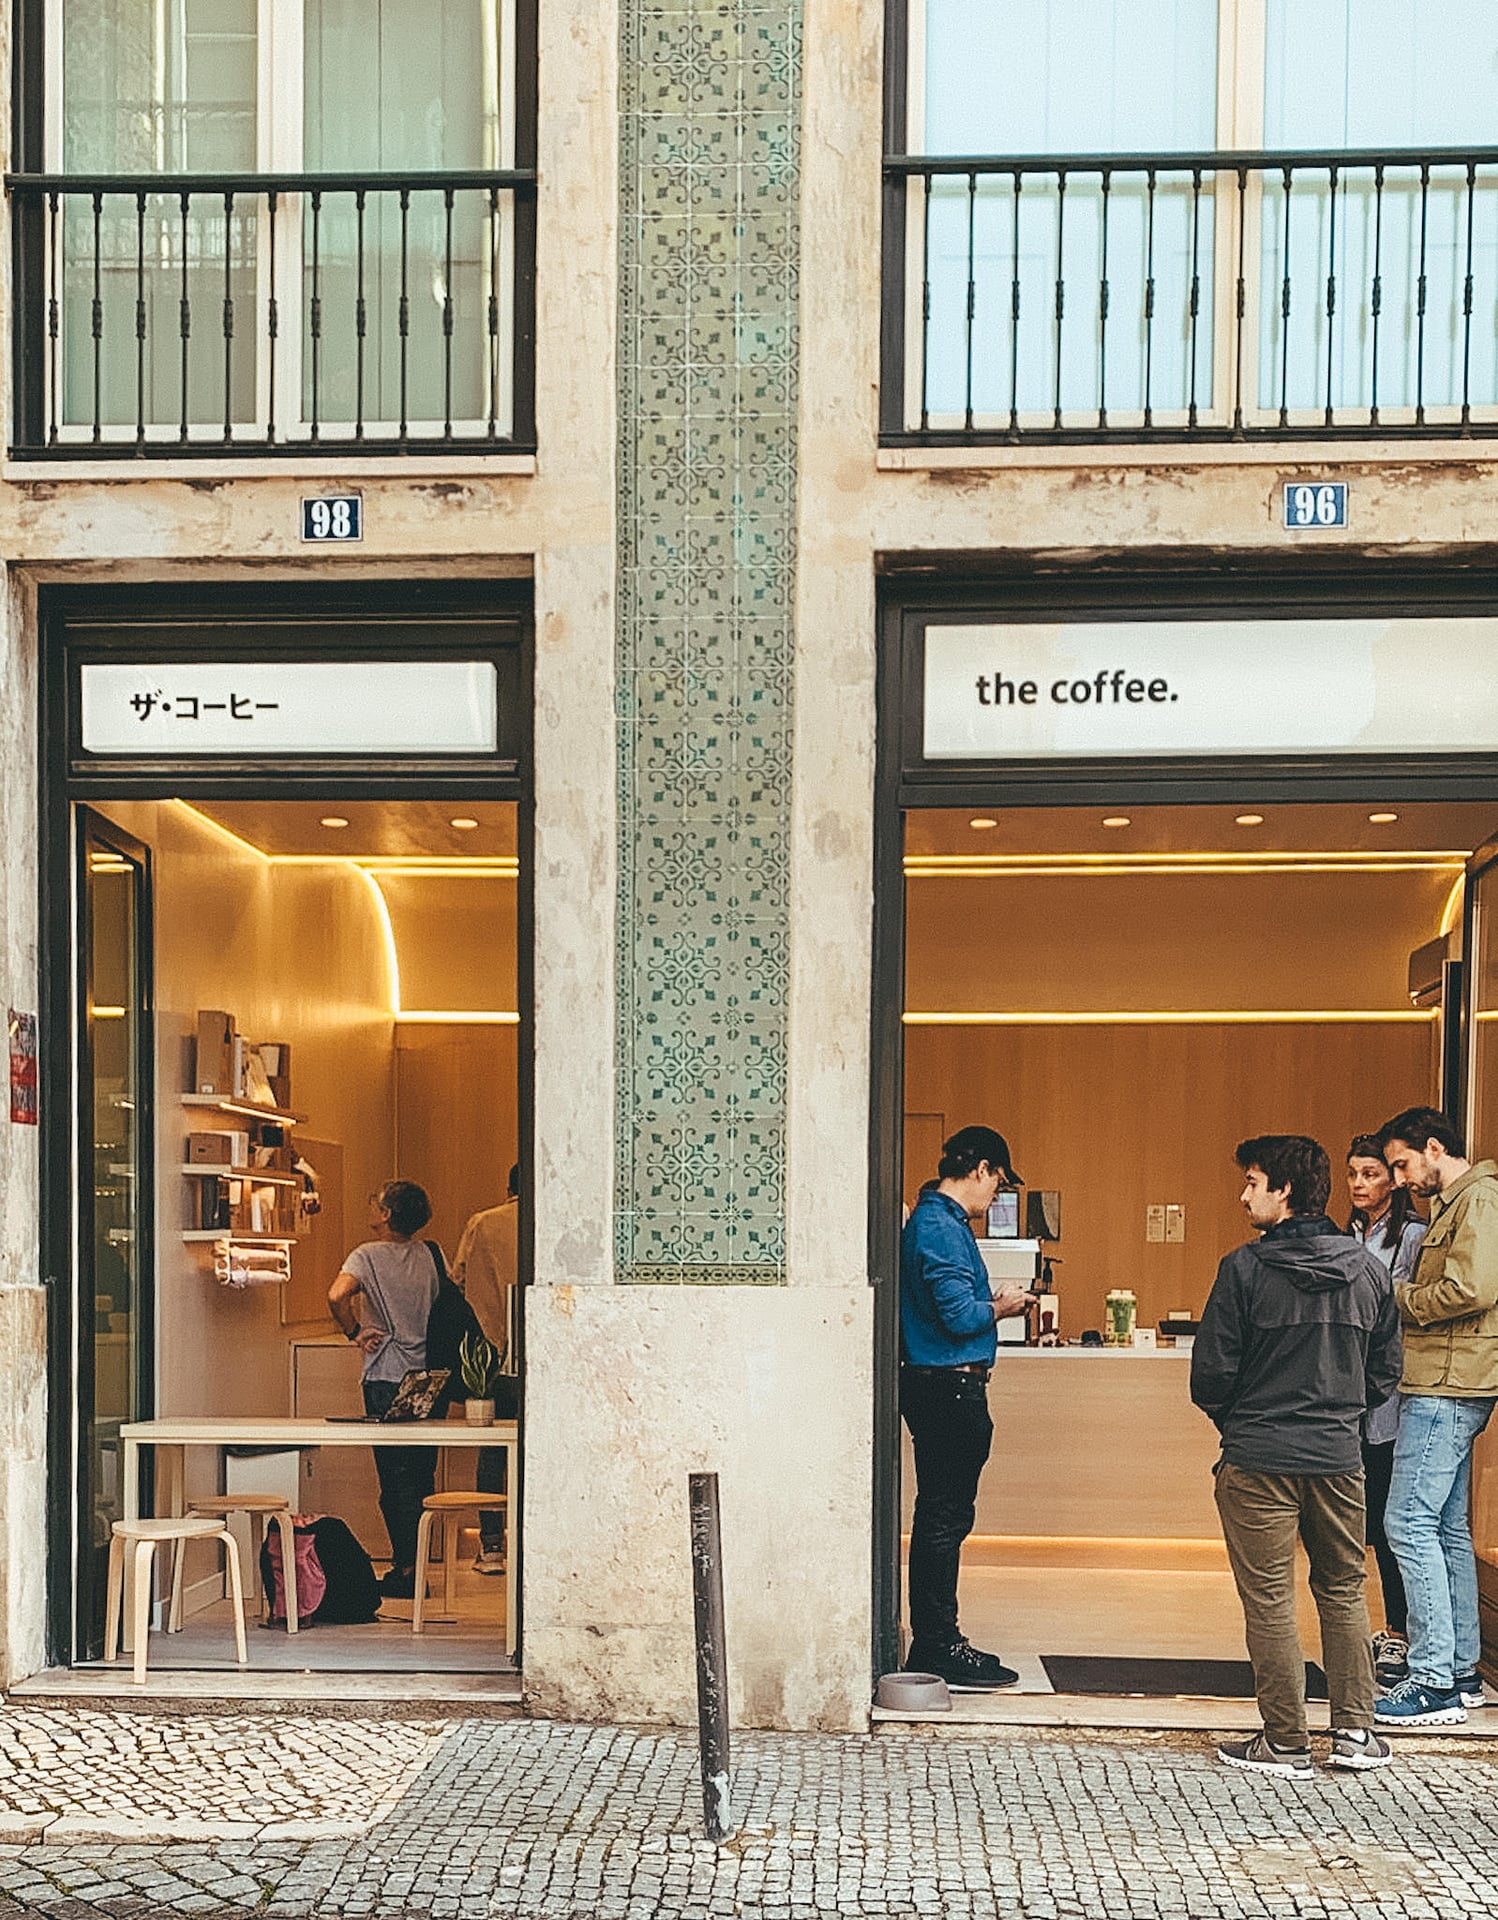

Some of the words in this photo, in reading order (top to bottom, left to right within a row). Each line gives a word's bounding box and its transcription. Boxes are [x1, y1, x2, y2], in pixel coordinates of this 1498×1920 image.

[310, 500, 351, 538] 98
[1294, 486, 1337, 525] 96
[976, 671, 1038, 705] the
[1050, 669, 1179, 704] coffee.
